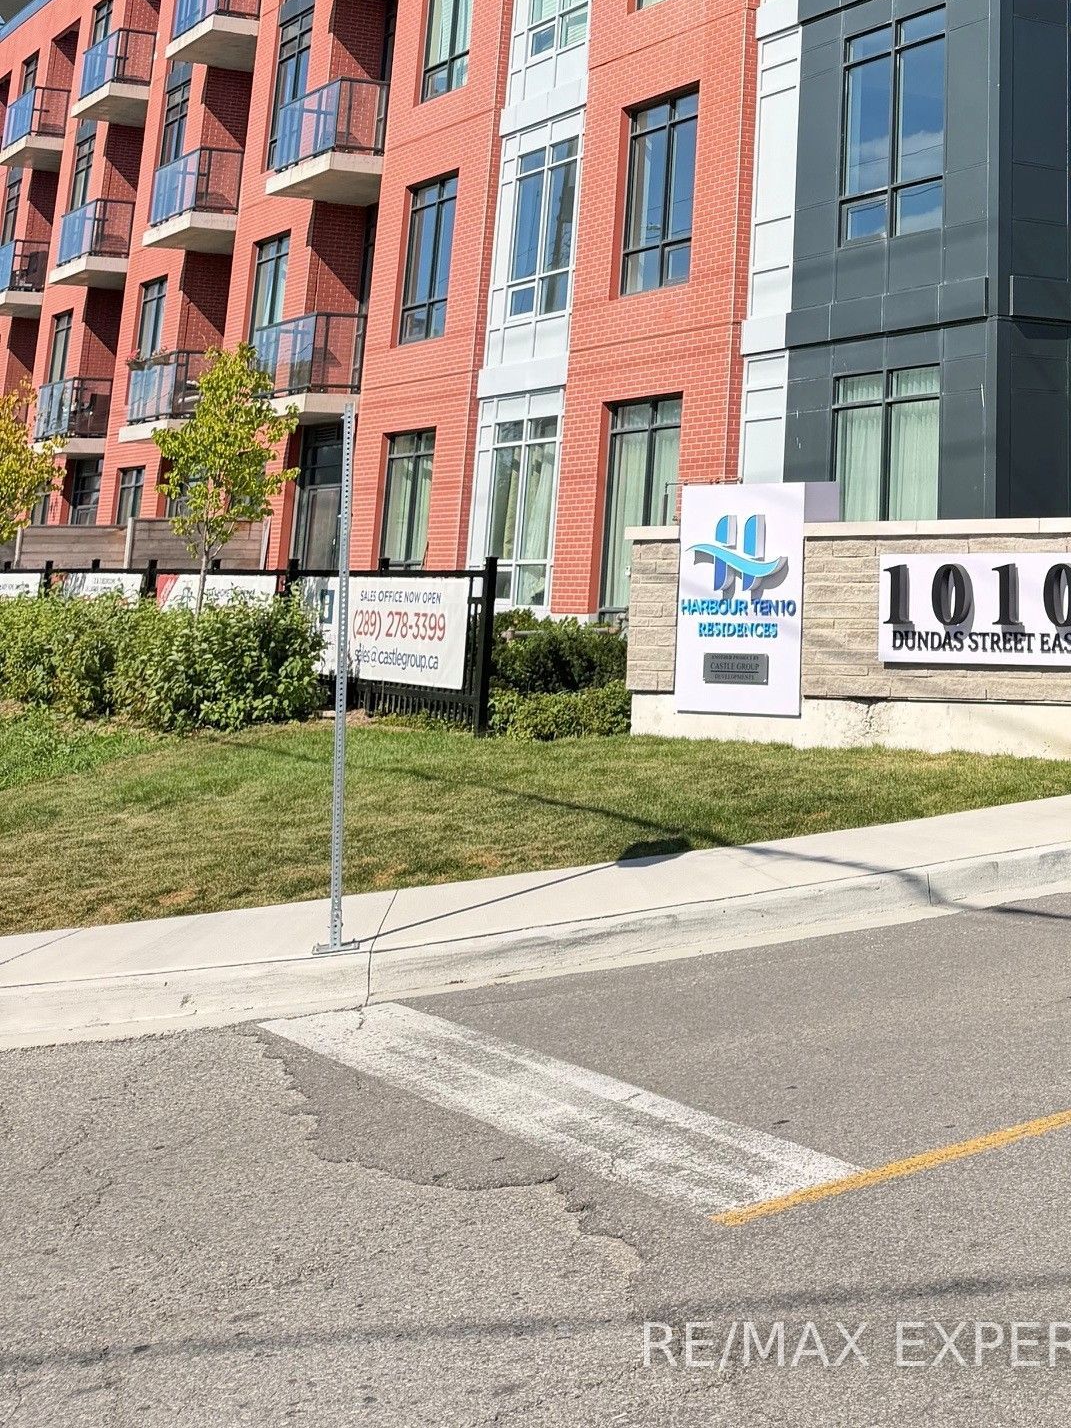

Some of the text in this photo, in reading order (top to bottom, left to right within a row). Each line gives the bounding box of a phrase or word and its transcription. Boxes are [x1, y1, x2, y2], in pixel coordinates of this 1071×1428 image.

[361, 590, 442, 605] SALES OFFICE NOW OPEN
[682, 598, 748, 616] HARBOUR
[353, 610, 446, 641] (289) 278-3399
[698, 622, 778, 639] RESIDENCES
[892, 629, 964, 651] DUNDAS
[968, 631, 1035, 653] STREET
[354, 644, 439, 672] sales@castlegroup.ca
[710, 662, 760, 671] CASTLE GROUP
